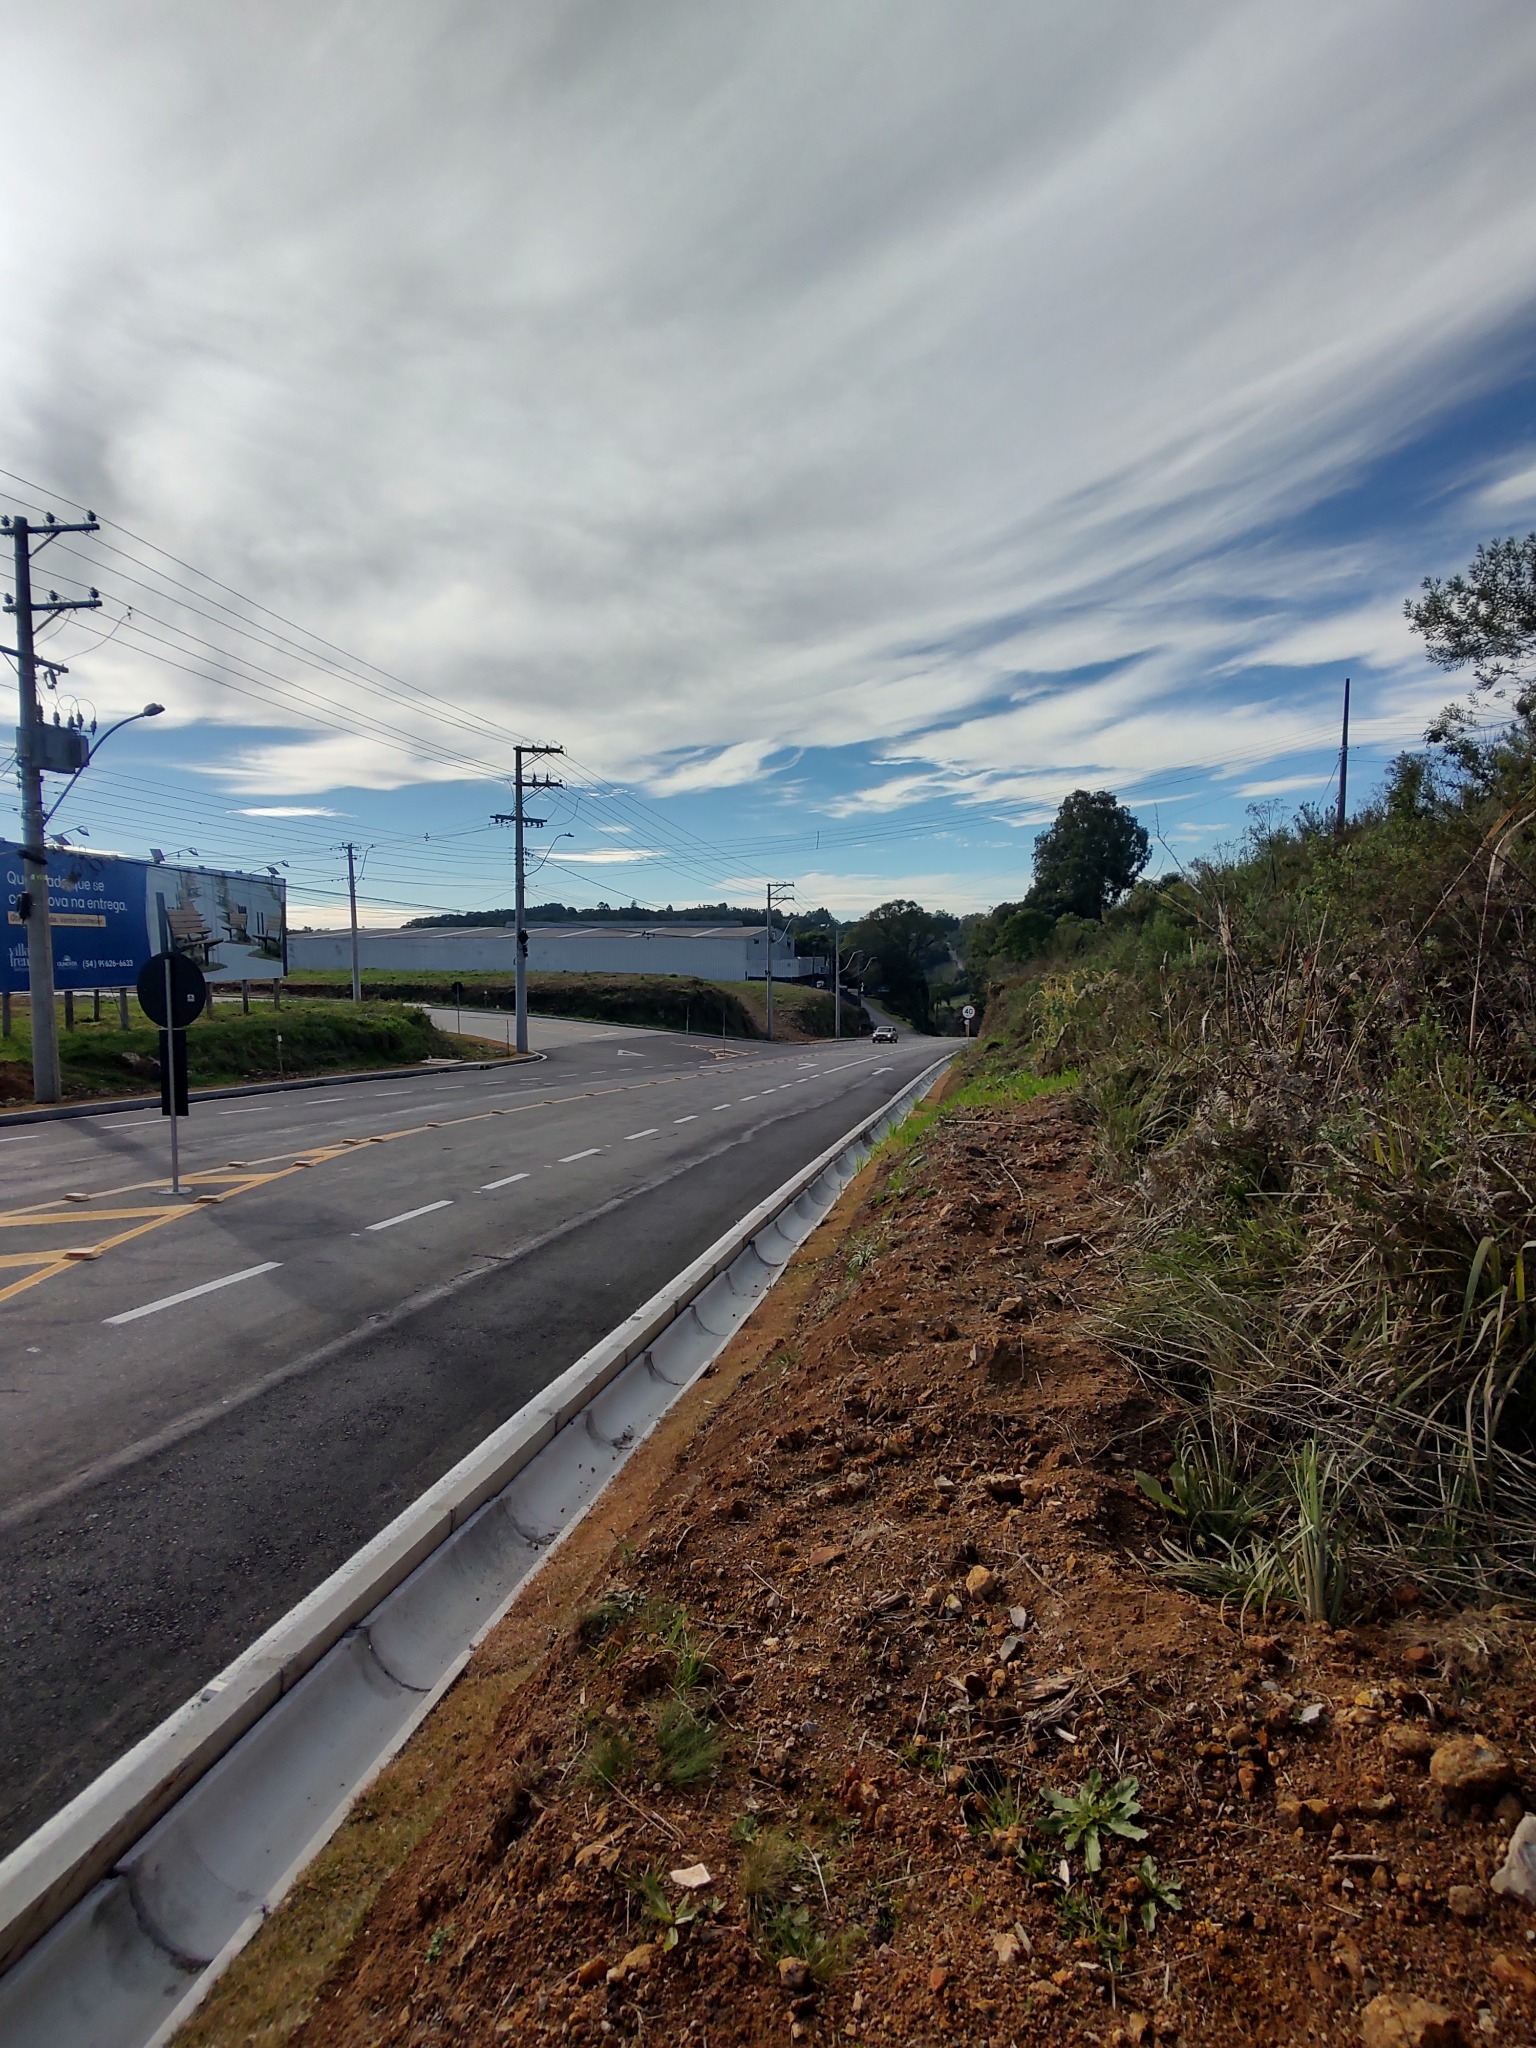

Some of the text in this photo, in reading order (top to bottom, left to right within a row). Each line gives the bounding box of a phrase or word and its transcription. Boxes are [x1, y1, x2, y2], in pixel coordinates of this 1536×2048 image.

[93, 881, 105, 891] se
[71, 898, 84, 908] na
[87, 899, 128, 913] entrega.
[82, 959, 97, 969] (54)
